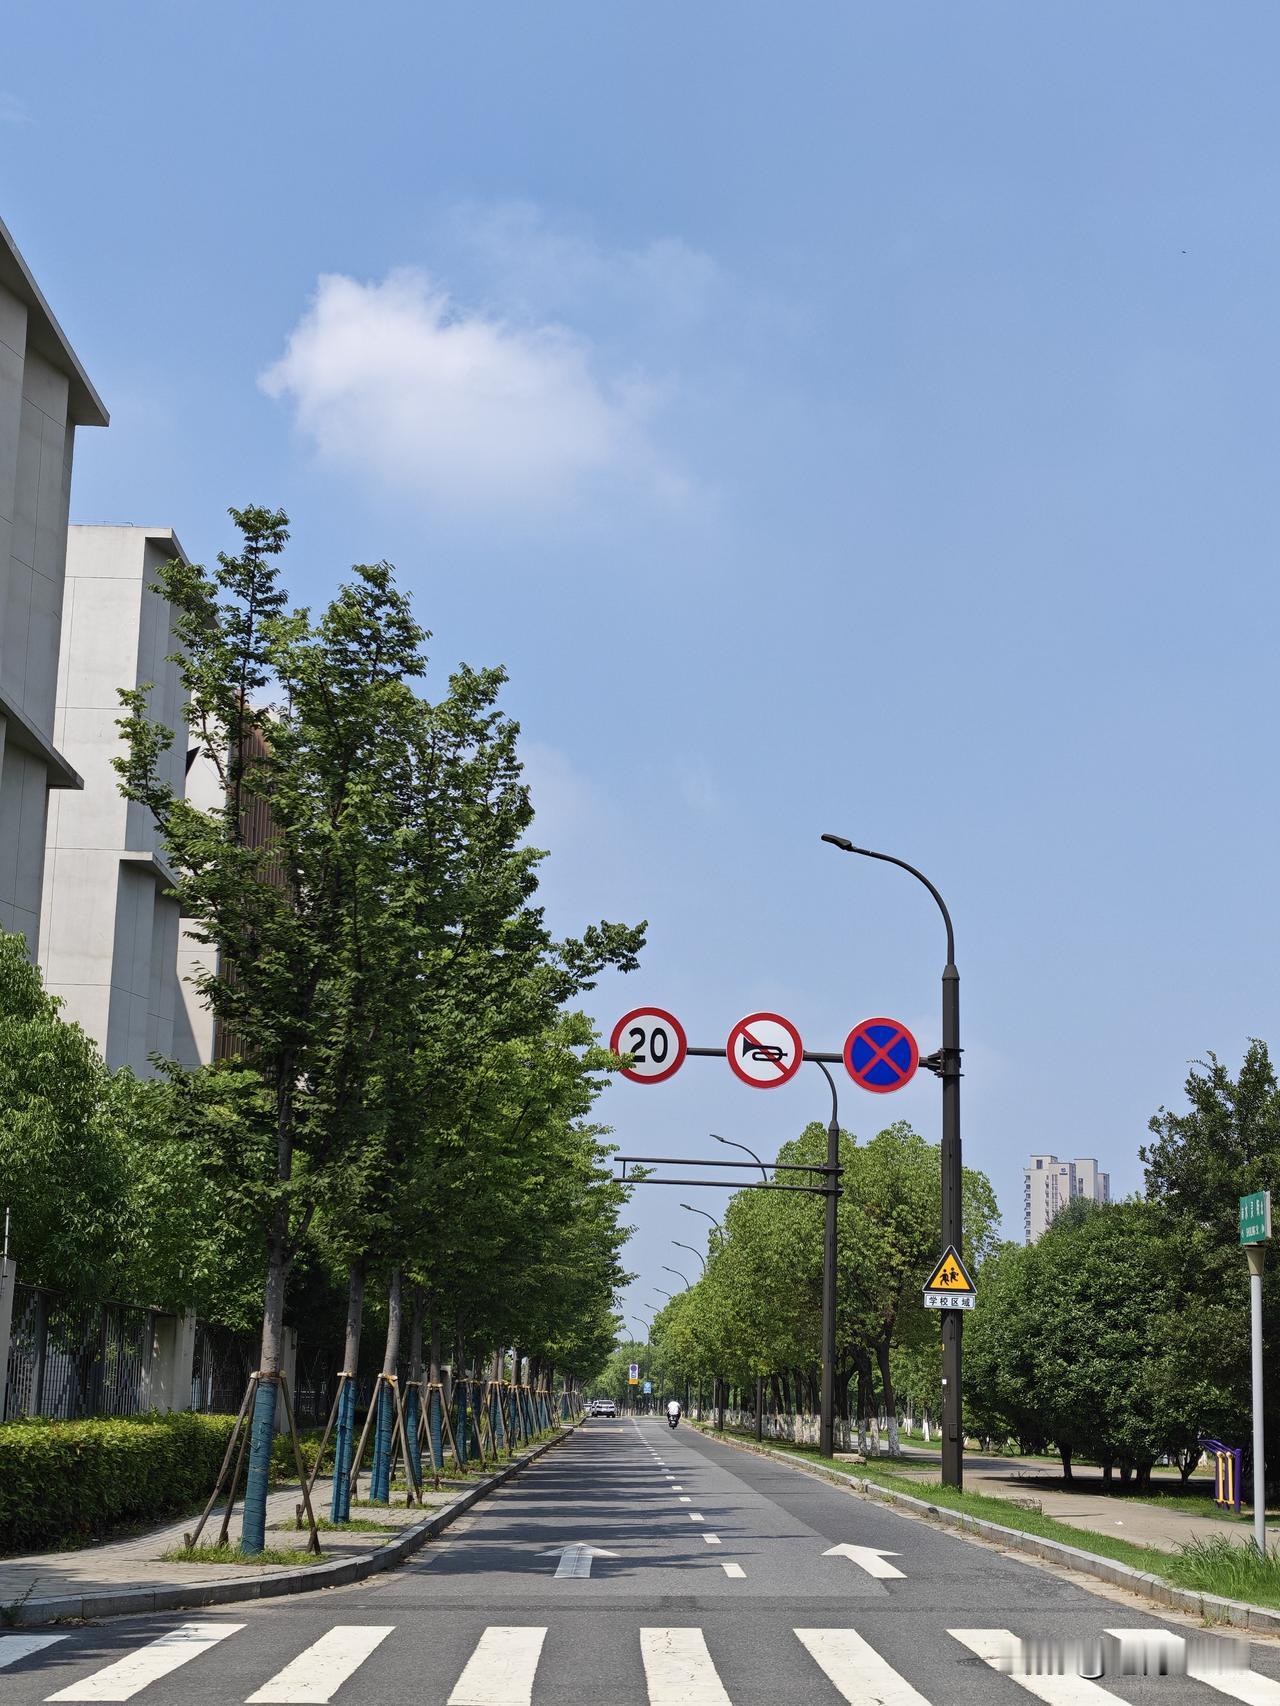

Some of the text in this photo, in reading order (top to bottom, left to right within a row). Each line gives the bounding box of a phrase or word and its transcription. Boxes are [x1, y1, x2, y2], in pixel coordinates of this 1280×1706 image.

[629, 1027, 669, 1064] 20
[928, 1296, 971, 1307] 学校区域
